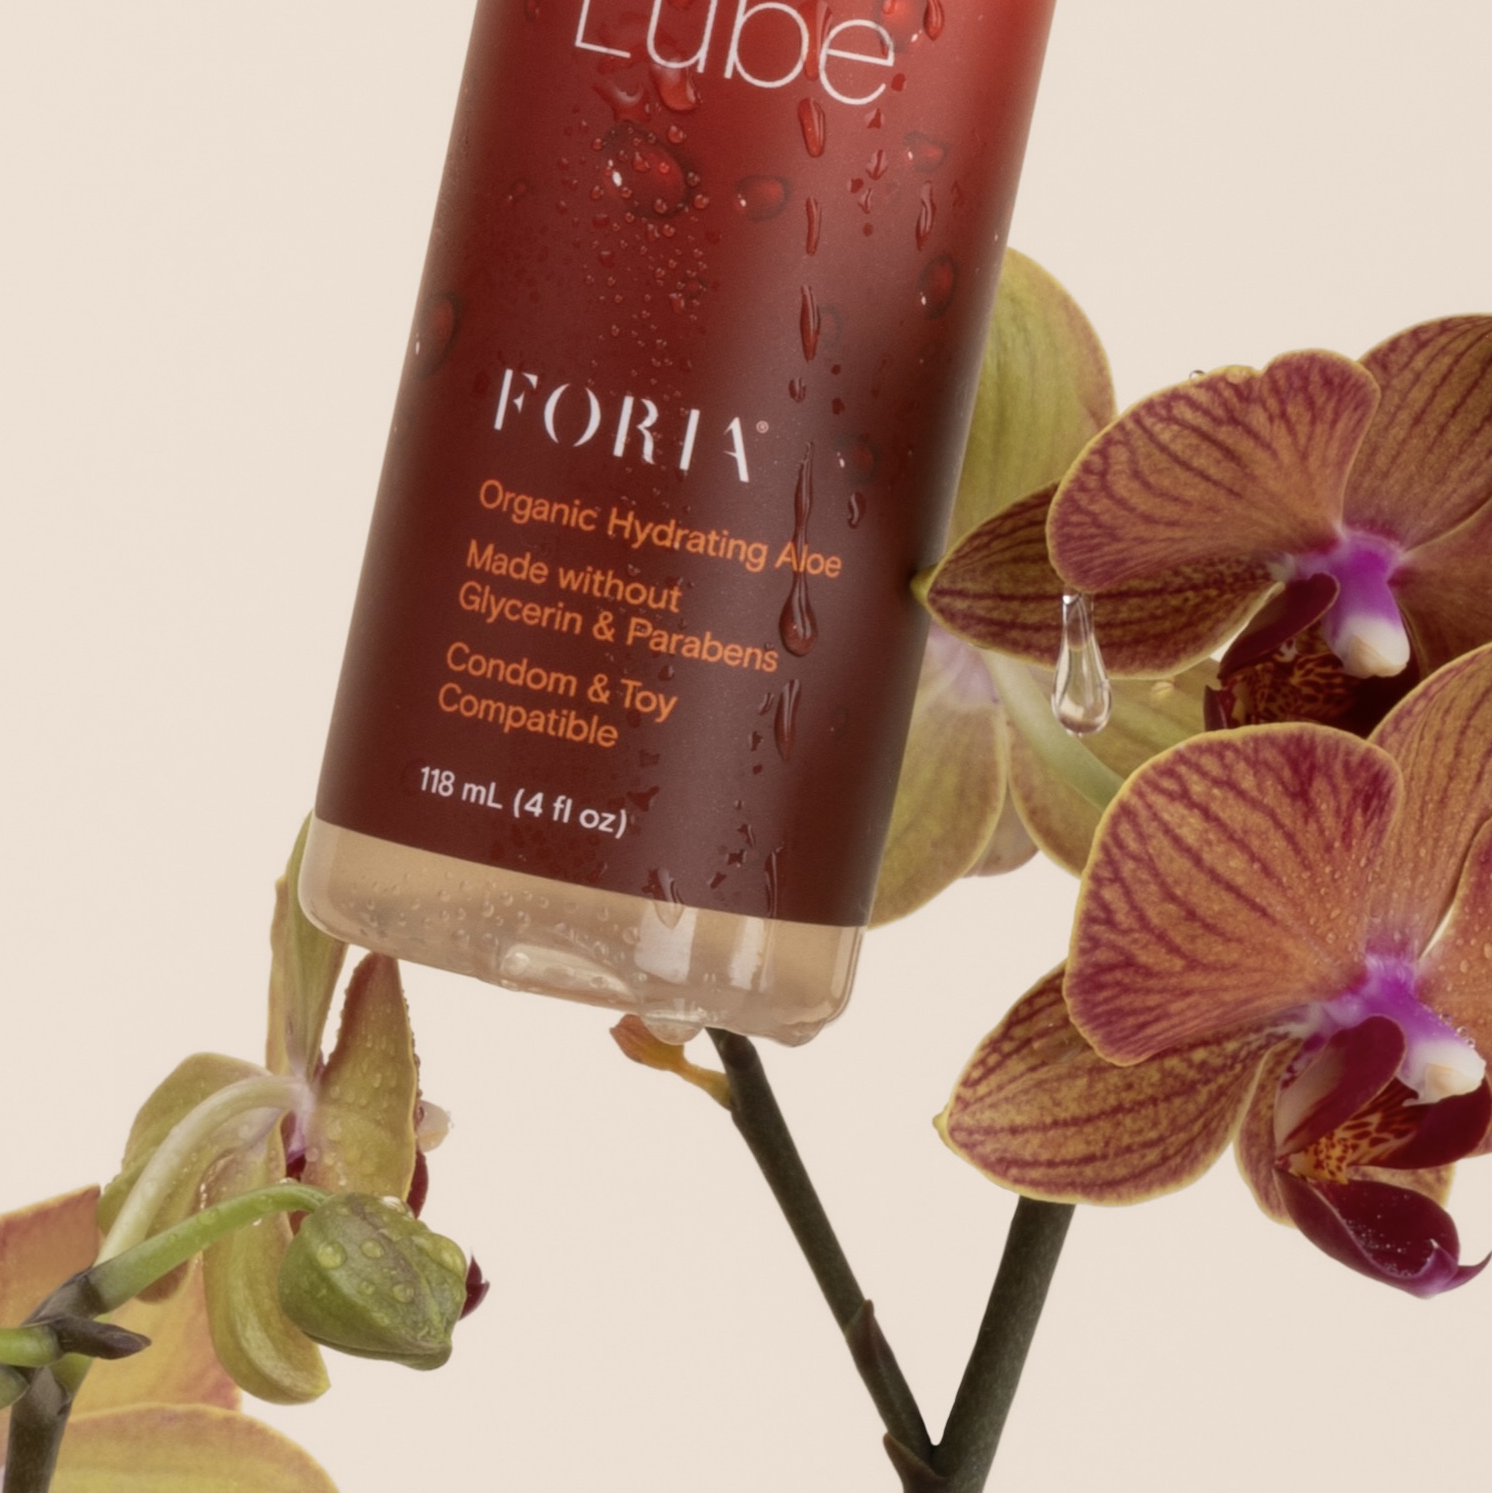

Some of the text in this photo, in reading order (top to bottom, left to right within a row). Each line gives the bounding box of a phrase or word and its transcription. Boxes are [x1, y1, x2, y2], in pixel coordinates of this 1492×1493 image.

[479, 479, 842, 577] Organic Hydrating Aloe
[466, 539, 682, 613] Made without
[459, 581, 778, 672] Glycerin & Parabens
[438, 682, 619, 748] Compatible
[446, 642, 678, 722] Condom & Toy
[420, 766, 628, 839] 118 mL (4 fl oz)
